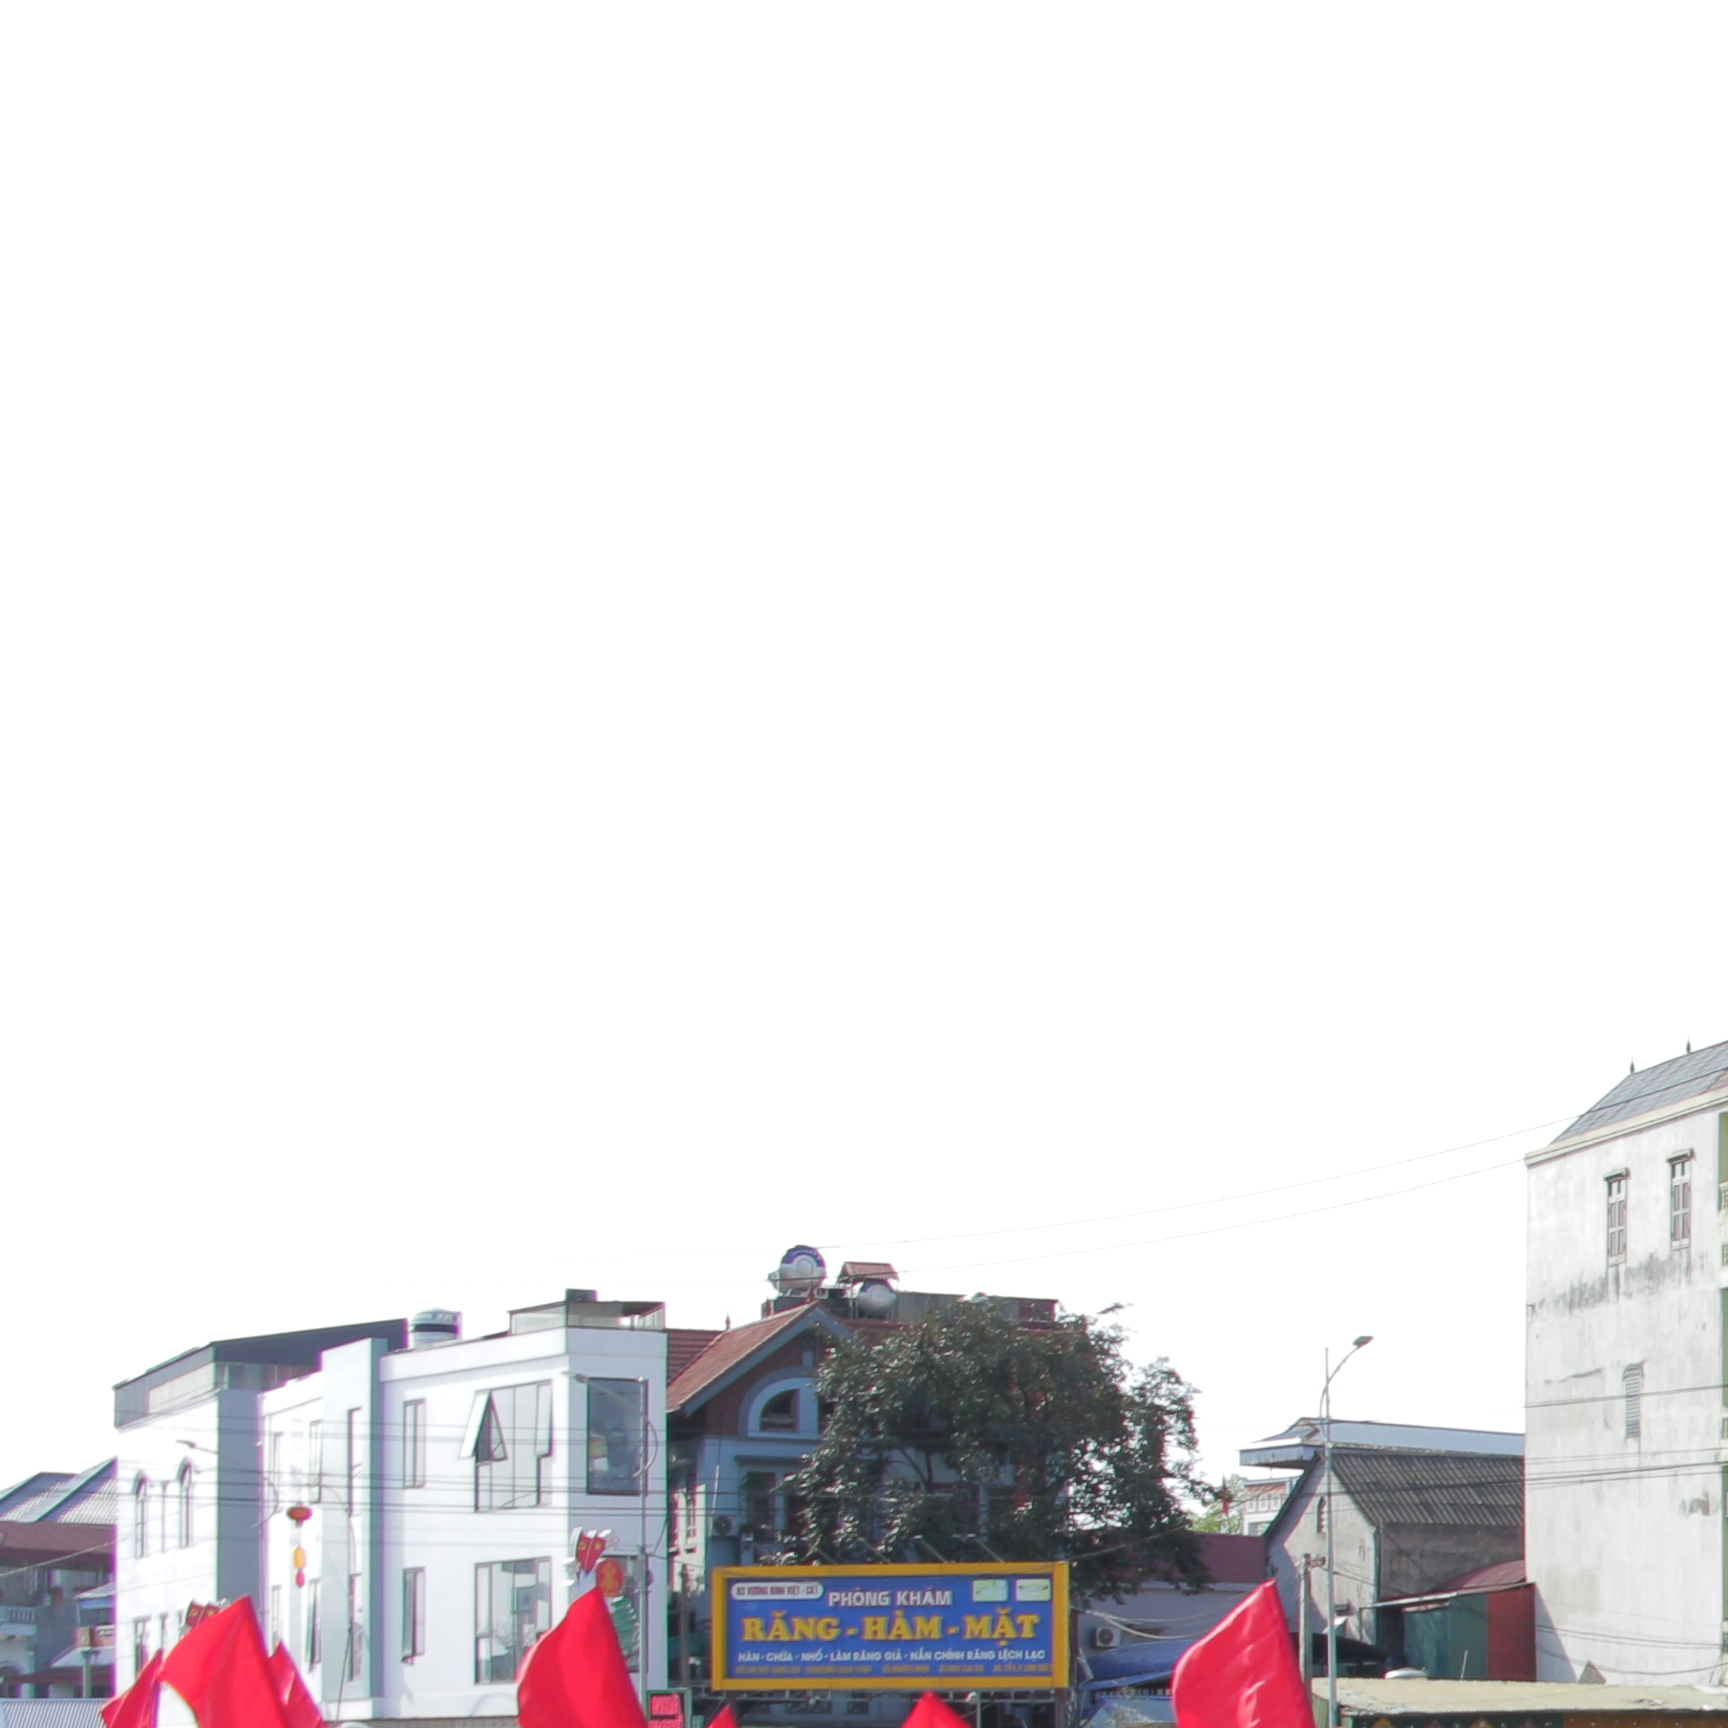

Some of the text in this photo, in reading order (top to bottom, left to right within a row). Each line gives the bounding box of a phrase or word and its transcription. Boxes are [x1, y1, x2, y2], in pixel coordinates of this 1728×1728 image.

[828, 1586, 953, 1607] PHÒNG KHÁM
[741, 1607, 1041, 1647] RĂNG HÀM MẶT
